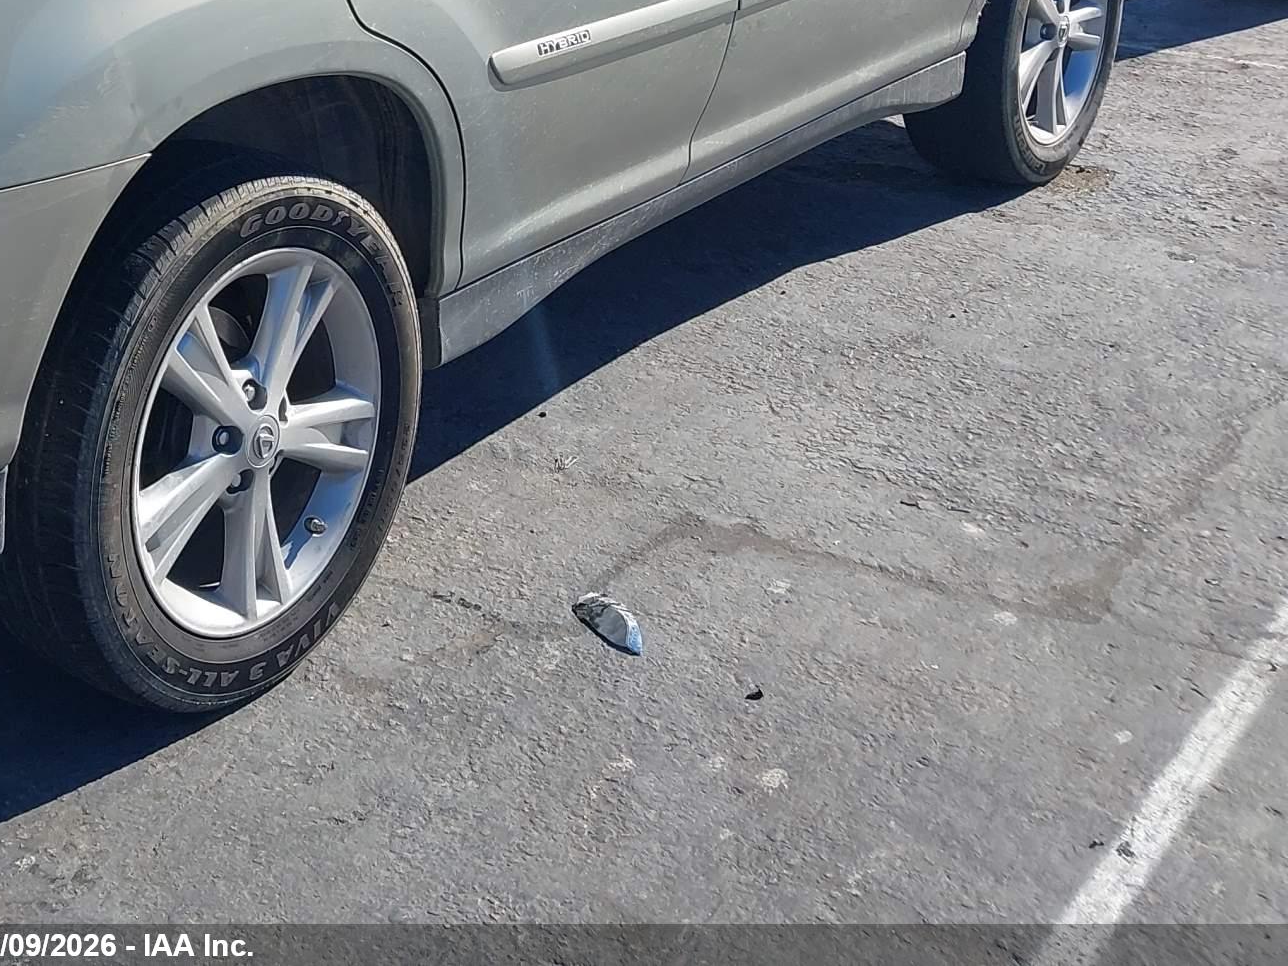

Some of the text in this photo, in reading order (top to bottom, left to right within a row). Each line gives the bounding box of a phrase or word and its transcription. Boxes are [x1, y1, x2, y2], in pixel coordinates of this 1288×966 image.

[538, 29, 591, 55] HYBRID
[240, 202, 402, 308] GOODYEAR
[276, 601, 337, 669] VIVA
